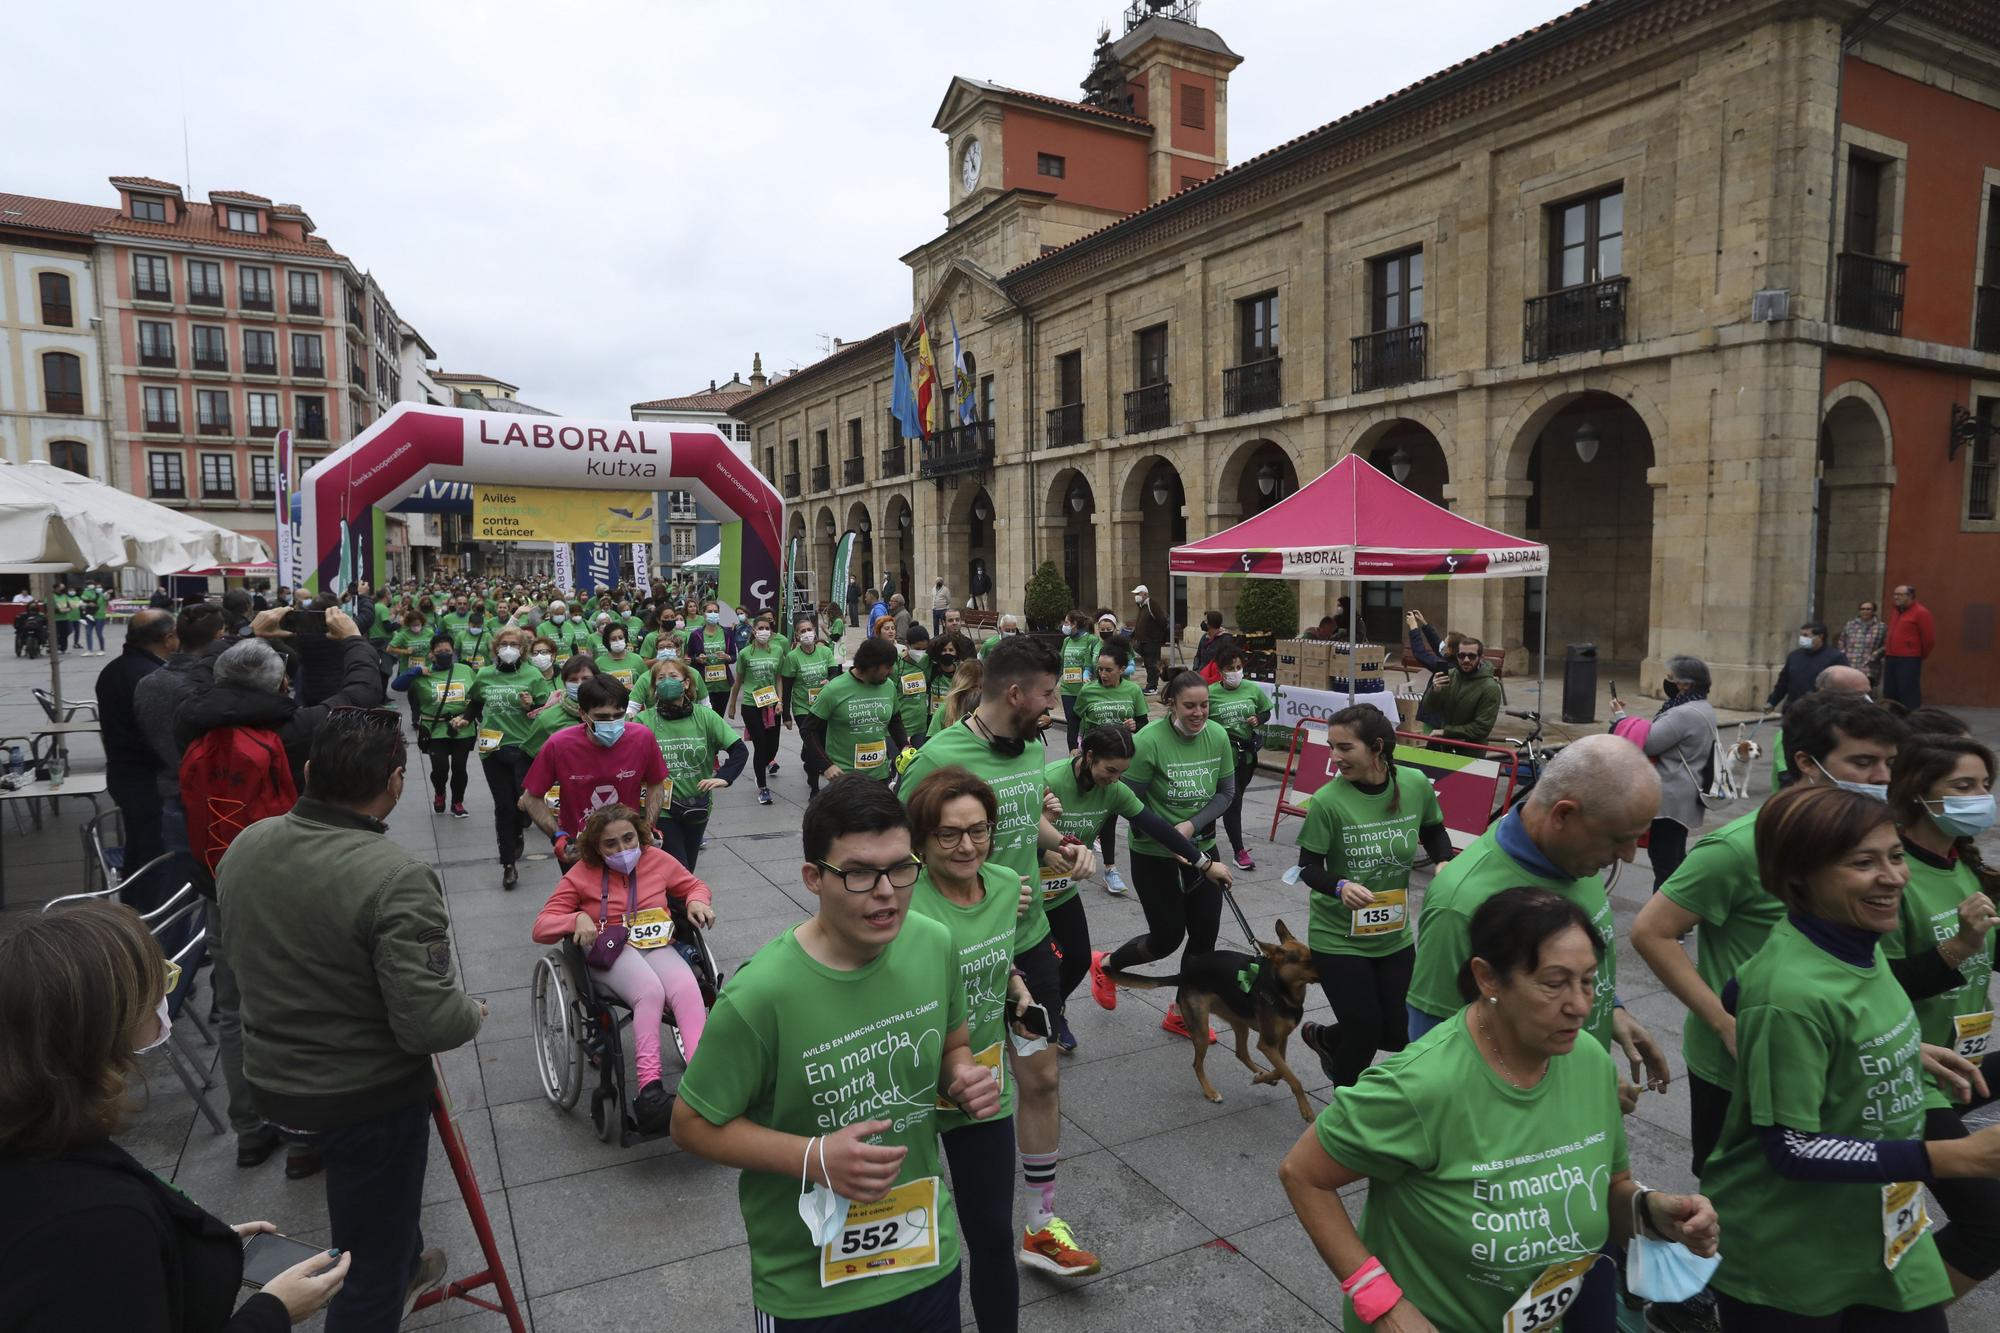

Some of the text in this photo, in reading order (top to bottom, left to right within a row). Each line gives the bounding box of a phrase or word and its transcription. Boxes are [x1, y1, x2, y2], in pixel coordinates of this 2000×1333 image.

[480, 419, 658, 455] LABORAL
[351, 441, 413, 488] banka kooperatiboa
[586, 457, 657, 478] kutxa
[715, 462, 760, 504] banca cooperativa
[482, 492, 517, 504] Avilés
[482, 516, 519, 527] contra
[482, 526, 534, 538] el cáncer
[1289, 551, 1345, 565] LABORAL
[1493, 550, 1541, 564] LABORAL
[1319, 566, 1345, 577] kutxa
[848, 701, 883, 711] En marcha
[848, 709, 871, 719] contra
[1286, 699, 1334, 721] aecc
[663, 742, 694, 751] marcha
[860, 752, 878, 762] 460
[1167, 766, 1210, 778] En marcha
[999, 780, 1035, 799] marcha
[1168, 779, 1196, 788] contra
[1167, 787, 1206, 798] el cáncer
[996, 813, 1032, 831] cáncer
[1343, 827, 1403, 844] En marcha
[1345, 843, 1383, 857] contra
[1347, 856, 1397, 870] el cáncer
[1045, 879, 1069, 891] 128
[1363, 909, 1390, 923] 135
[634, 924, 662, 939] 549
[1932, 924, 1953, 941] En
[963, 943, 984, 955] MARCHA
[983, 935, 1002, 948] CONTRA
[960, 948, 1008, 976] marcha
[802, 1000, 940, 1060] AVILÉS EN MARCHA CONTRA EL CÁNCER
[805, 1031, 912, 1086] En marcha
[1859, 1054, 1892, 1076] En
[811, 1070, 876, 1107] contra
[817, 1108, 837, 1128] el
[838, 1085, 901, 1128] cáncer
[1861, 1098, 1884, 1121] el
[1471, 1159, 1505, 1173] AVILÉS
[1504, 1158, 1515, 1168] EN
[1514, 1151, 1545, 1165] MARCHA
[1544, 1144, 1575, 1159] CONTRA
[1574, 1141, 1584, 1150] EL
[1472, 1163, 1584, 1202] En marcha
[868, 1205, 895, 1217] cáncer
[1471, 1205, 1550, 1233] contra
[841, 1221, 899, 1255] 552
[1471, 1238, 1497, 1263] el
[1504, 1231, 1580, 1264] cáncer
